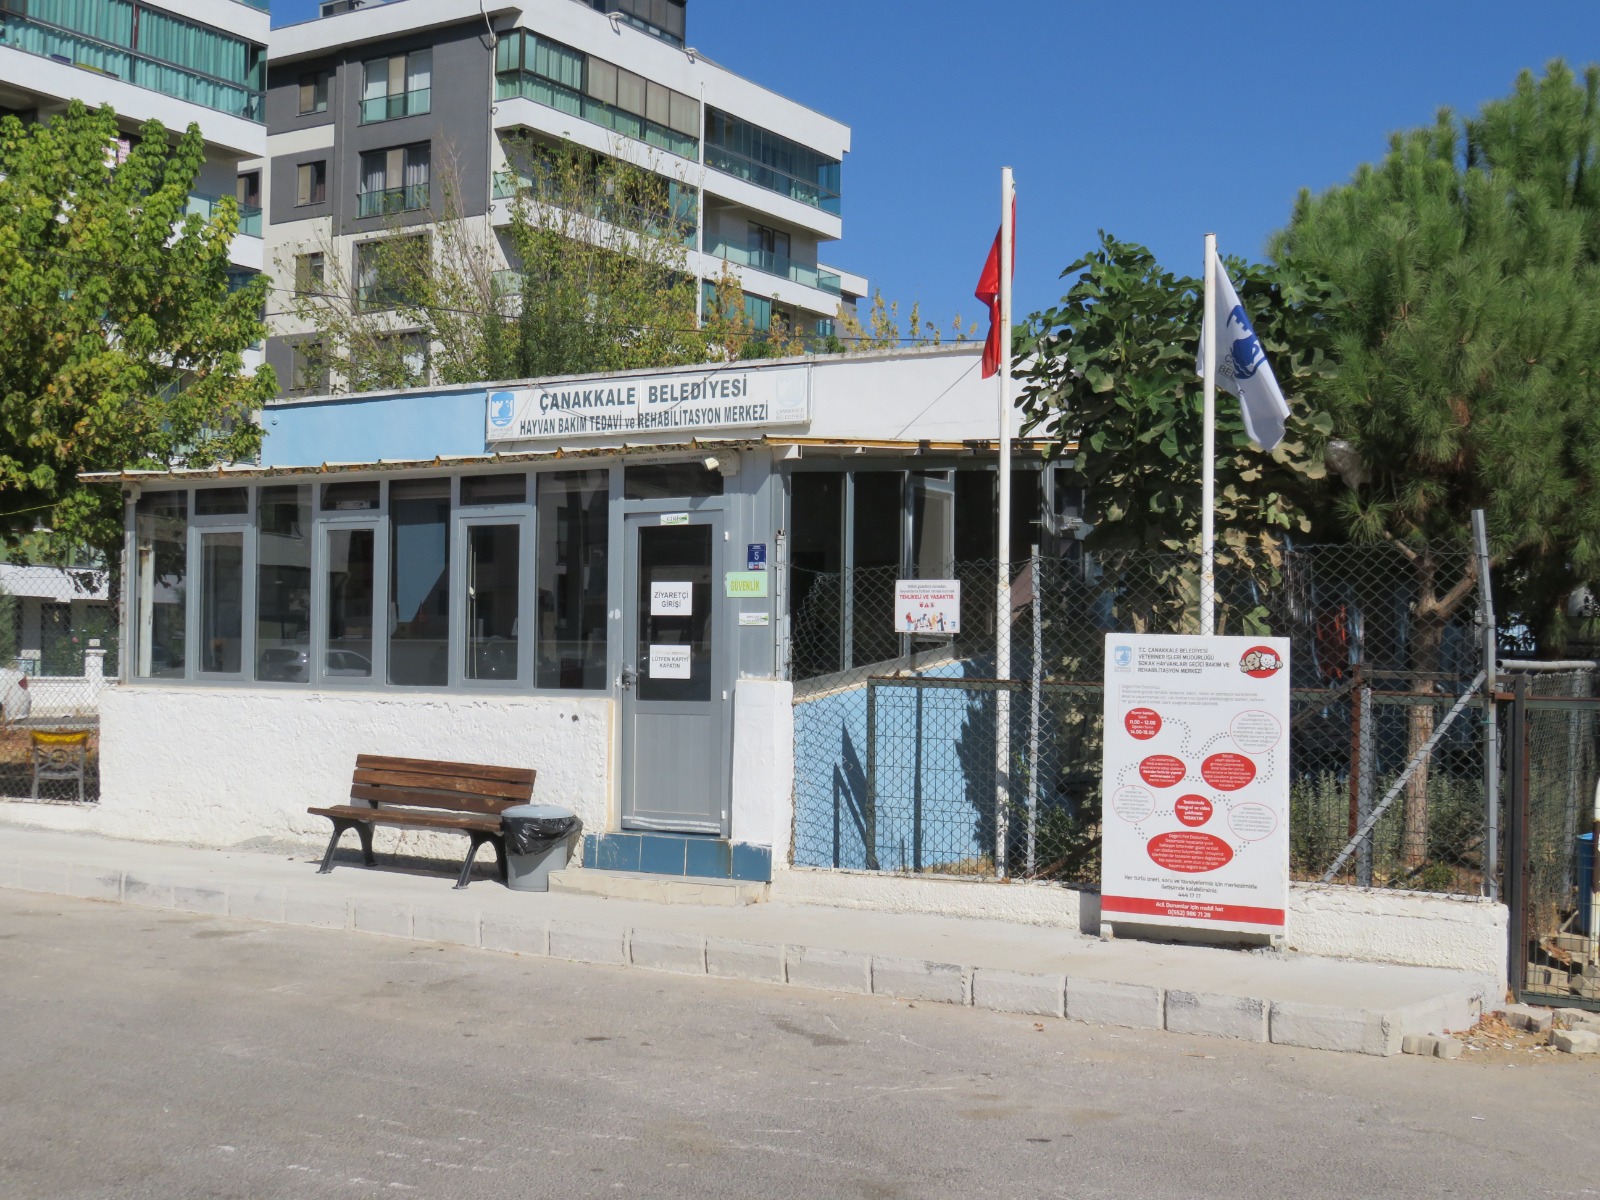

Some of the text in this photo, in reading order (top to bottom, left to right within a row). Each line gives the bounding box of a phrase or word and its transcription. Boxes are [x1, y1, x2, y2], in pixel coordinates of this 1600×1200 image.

[539, 373, 747, 415] ÇANAKKALE BELEDİYESİ
[520, 418, 555, 436] HAYVAN
[558, 415, 587, 434] BAKIM
[590, 410, 622, 431] TEDAVİ
[624, 418, 635, 430] ve
[637, 405, 721, 429] REHABİLİTASYON
[724, 400, 768, 423] MERKEZİ
[754, 551, 760, 561] 5
[730, 578, 760, 591] GÜVENLİK
[654, 591, 689, 600] ZİYARETÇİ
[661, 600, 681, 609] GİRİŞİ
